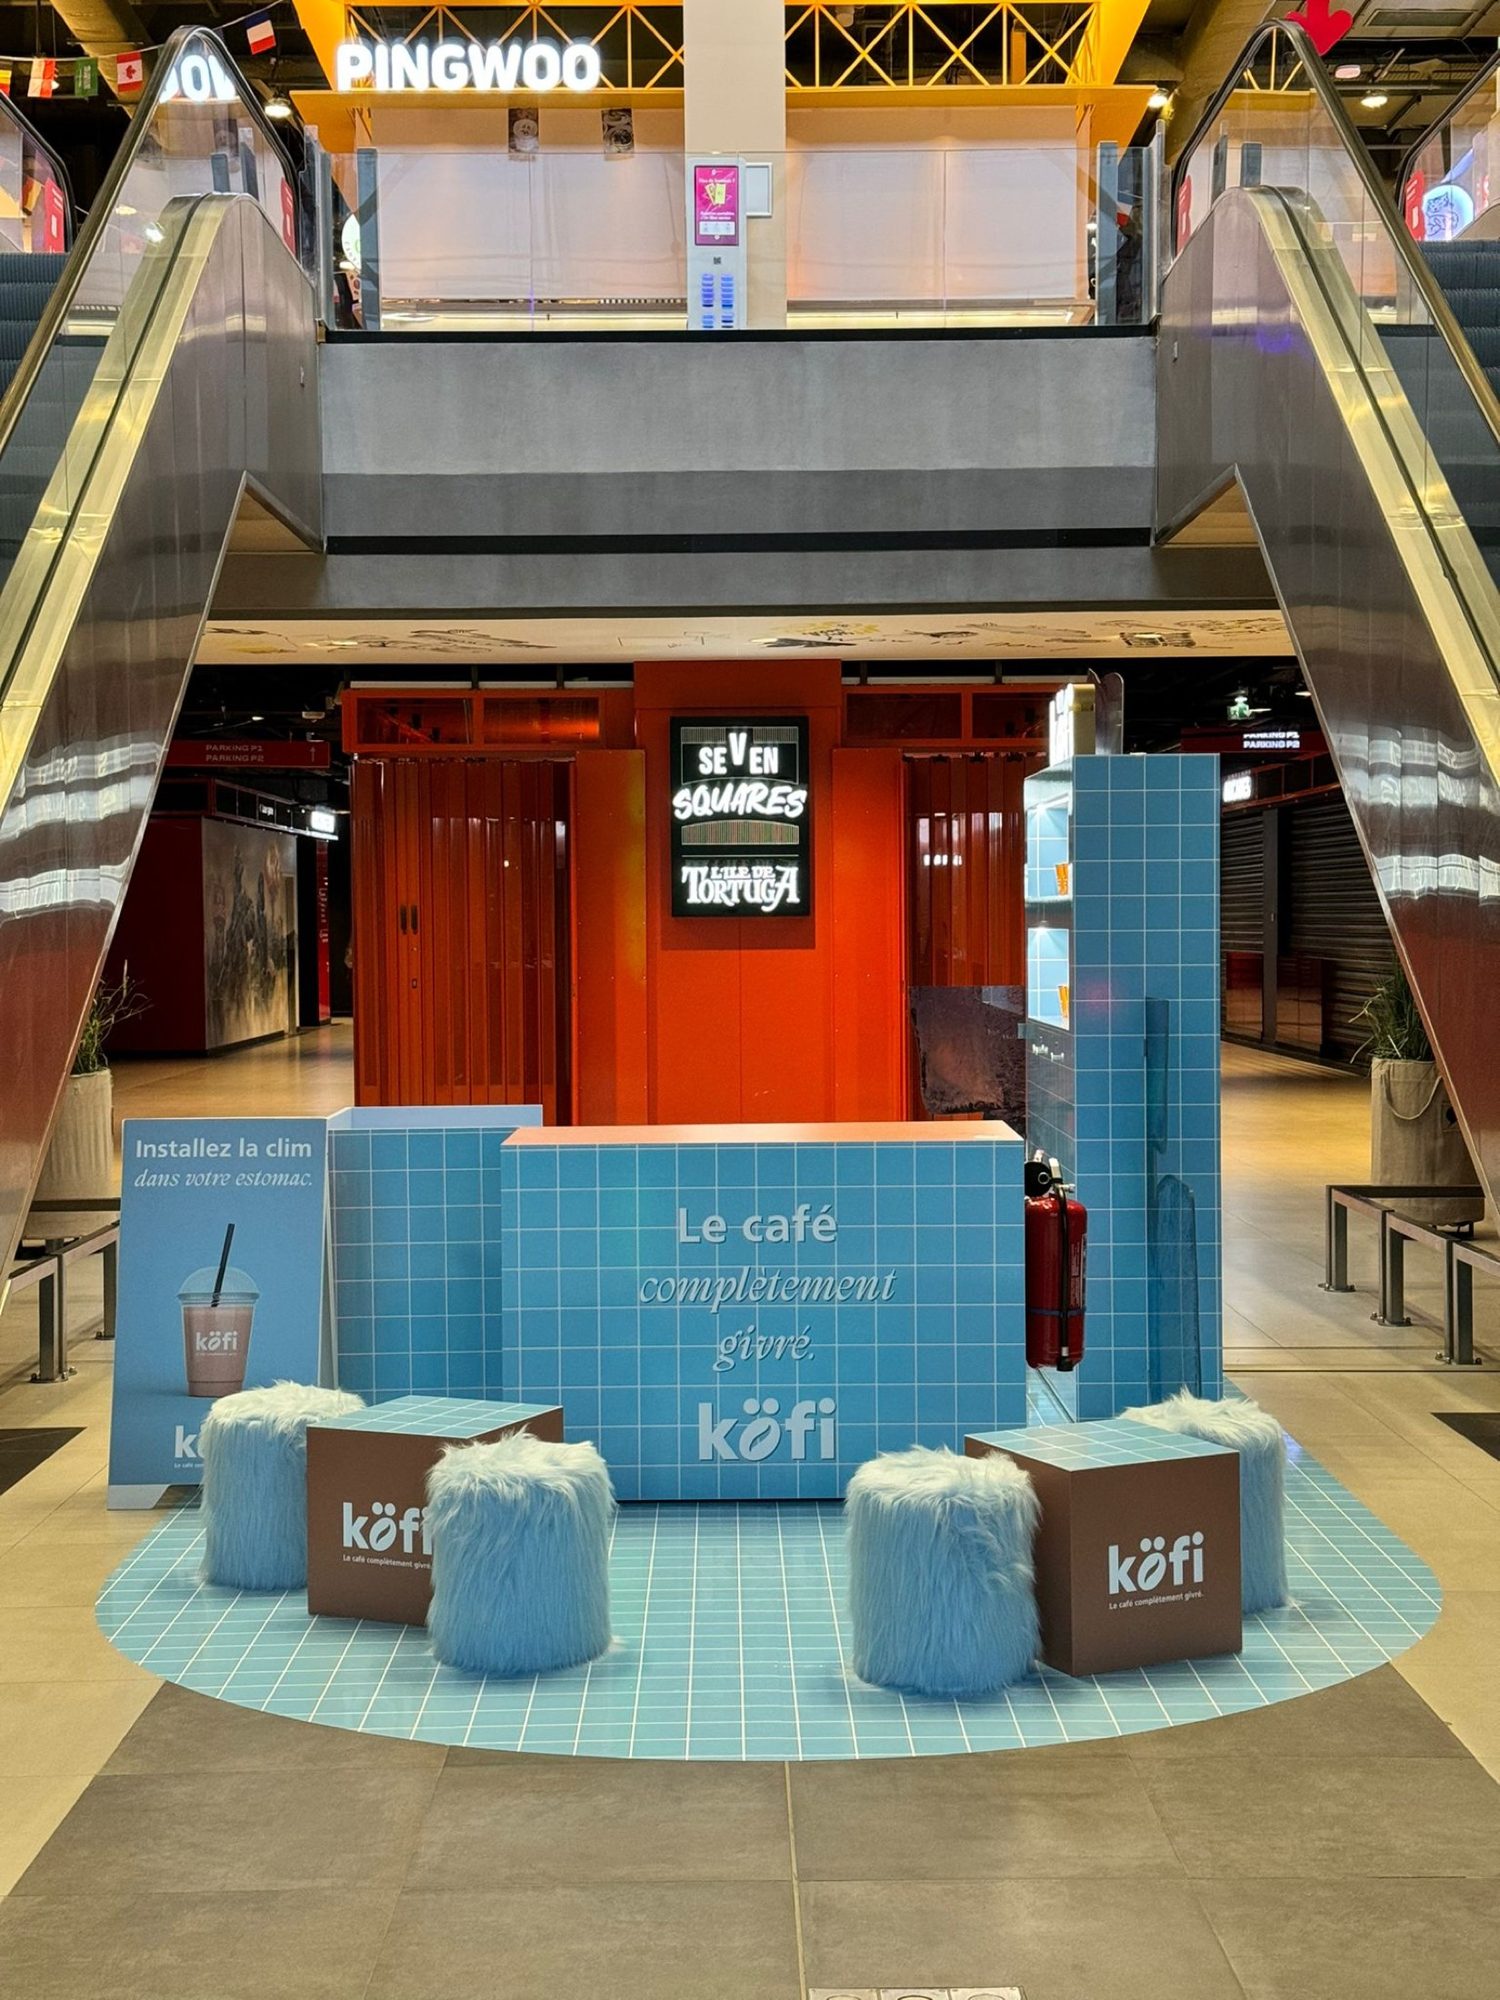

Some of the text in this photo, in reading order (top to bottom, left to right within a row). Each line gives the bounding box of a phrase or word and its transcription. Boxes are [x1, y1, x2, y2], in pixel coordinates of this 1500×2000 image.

[337, 43, 600, 91] PINGWOO
[206, 744, 263, 752] PARKING P1
[251, 754, 264, 762] P2
[699, 732, 779, 775] SEVEN
[1243, 740, 1285, 748] PARKING
[672, 782, 808, 820] SQUARES
[681, 866, 800, 912] TORTUGA
[136, 1138, 312, 1158] Installez la clim
[134, 1169, 313, 1187] dans votre estomac.
[678, 1204, 838, 1243] Le café
[640, 1266, 897, 1314] complètement
[196, 1330, 238, 1351] köfi
[713, 1325, 816, 1372] givré.
[699, 1398, 837, 1461] köfi
[1108, 1531, 1204, 1595] köfi
[1108, 1602, 1117, 1610] Le
[1119, 1600, 1133, 1609] café
[1134, 1593, 1184, 1606] complètement
